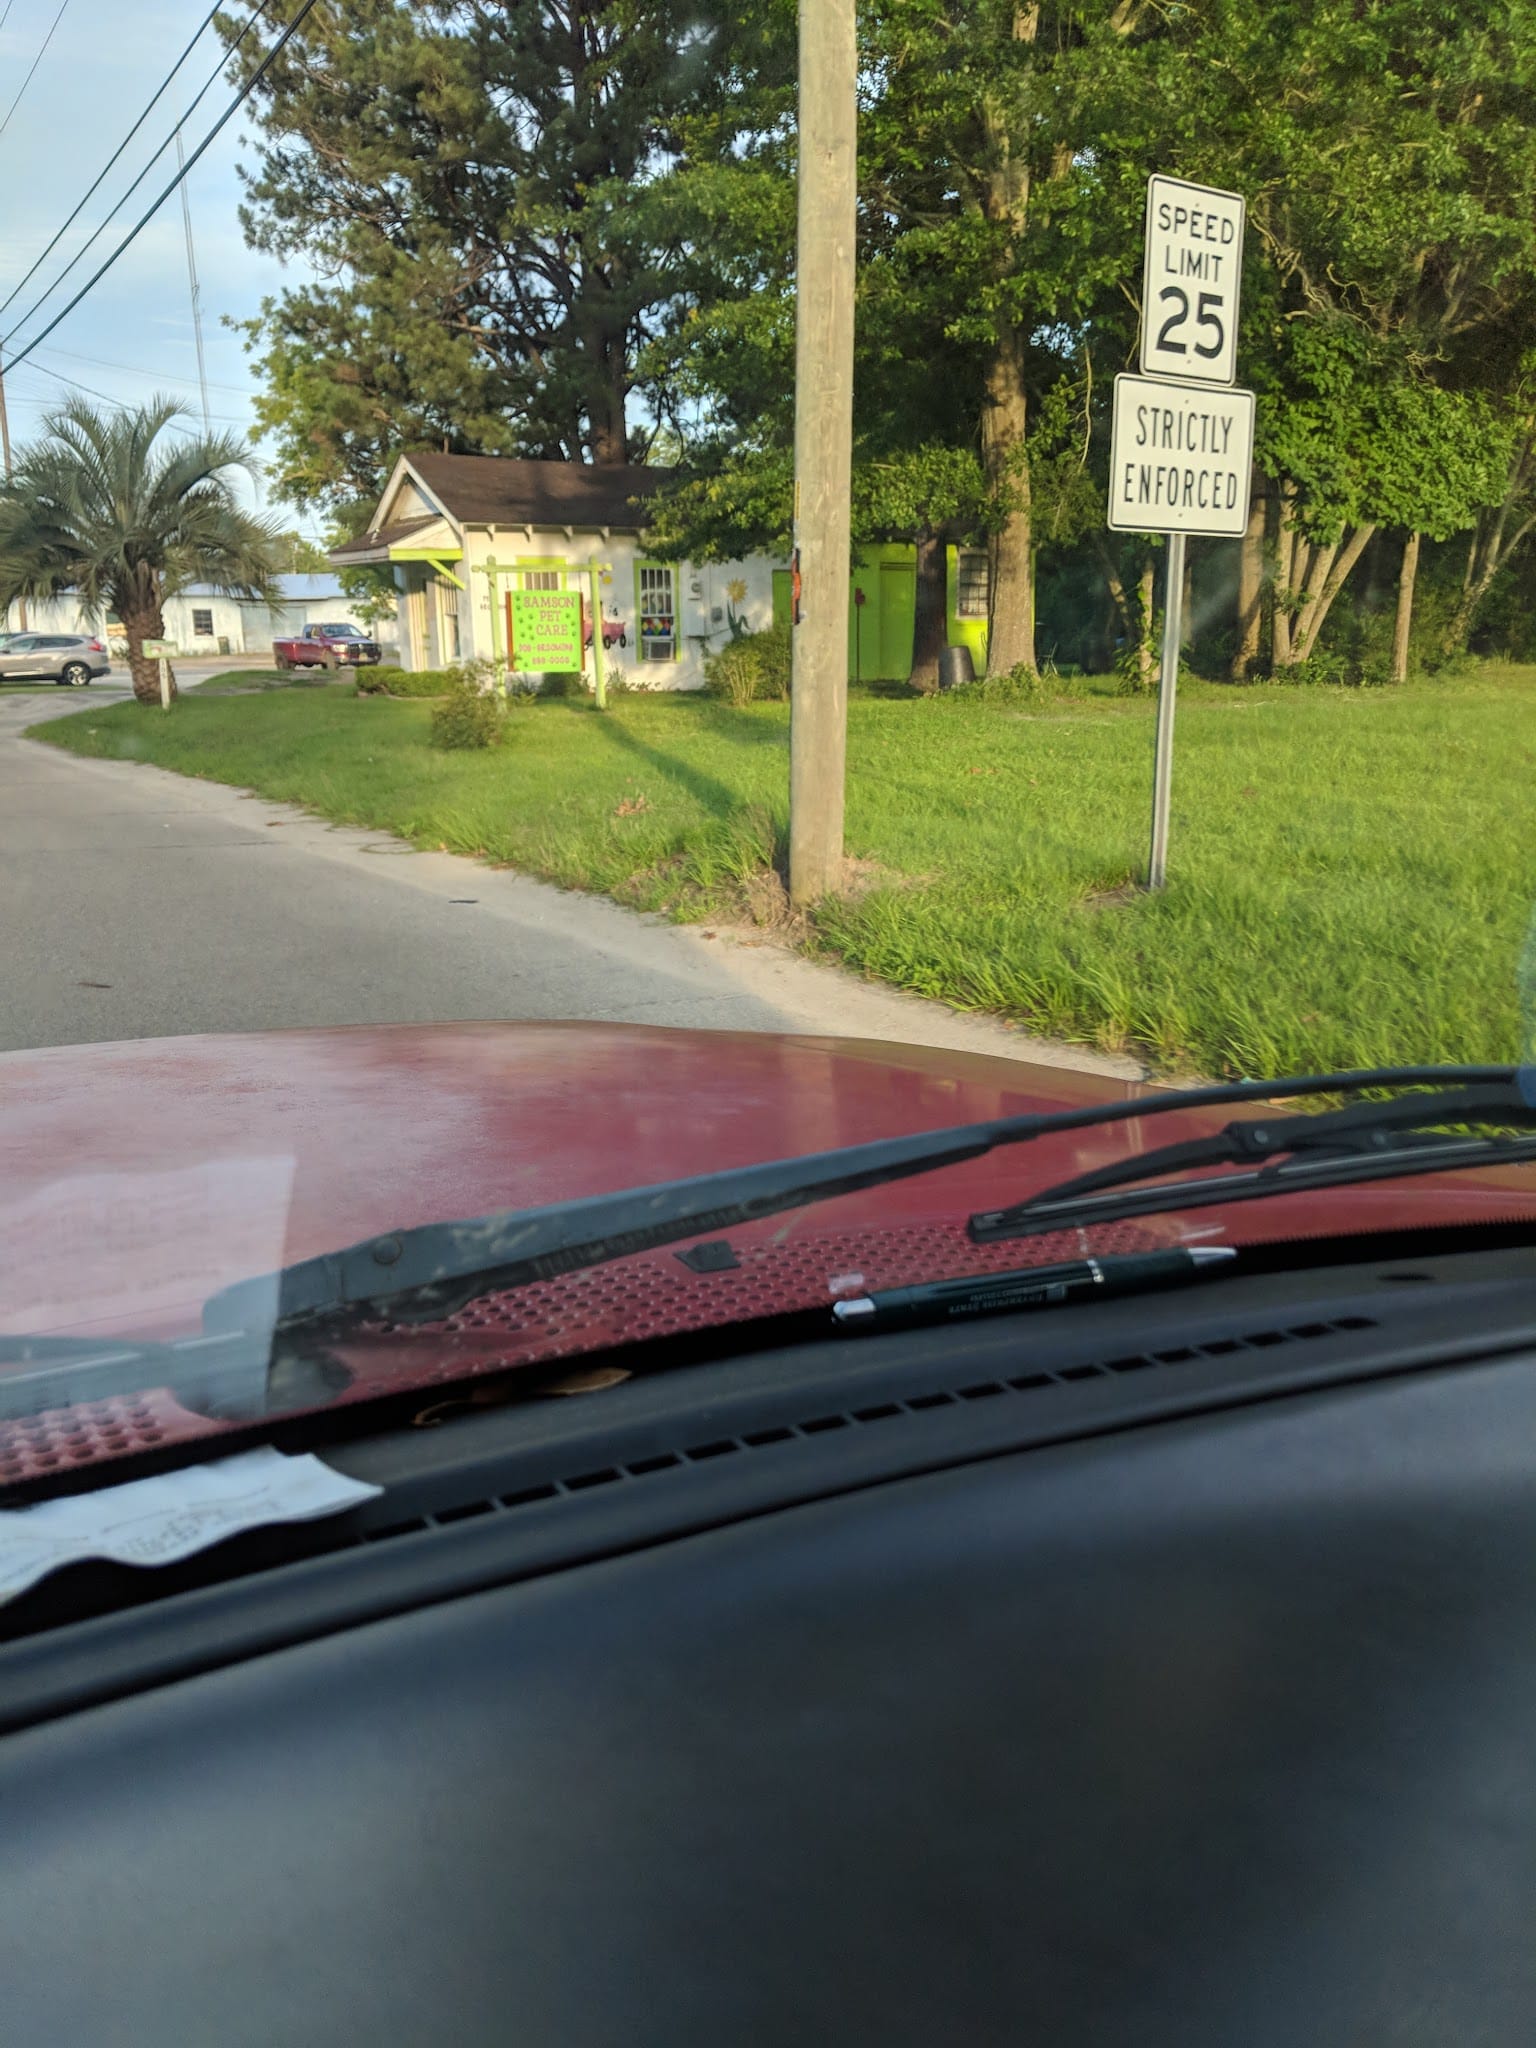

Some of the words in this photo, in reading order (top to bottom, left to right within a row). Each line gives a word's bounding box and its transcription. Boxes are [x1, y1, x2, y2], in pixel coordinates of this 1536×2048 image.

[1157, 203, 1234, 245] SPEED
[1165, 245, 1223, 282] LIMIT
[1156, 286, 1224, 359] 25
[1136, 404, 1233, 454] STRICTLY
[1123, 463, 1238, 510] ENFORCED
[523, 596, 575, 608] SAMSON
[539, 610, 561, 622] PET
[536, 623, 569, 636] CARE
